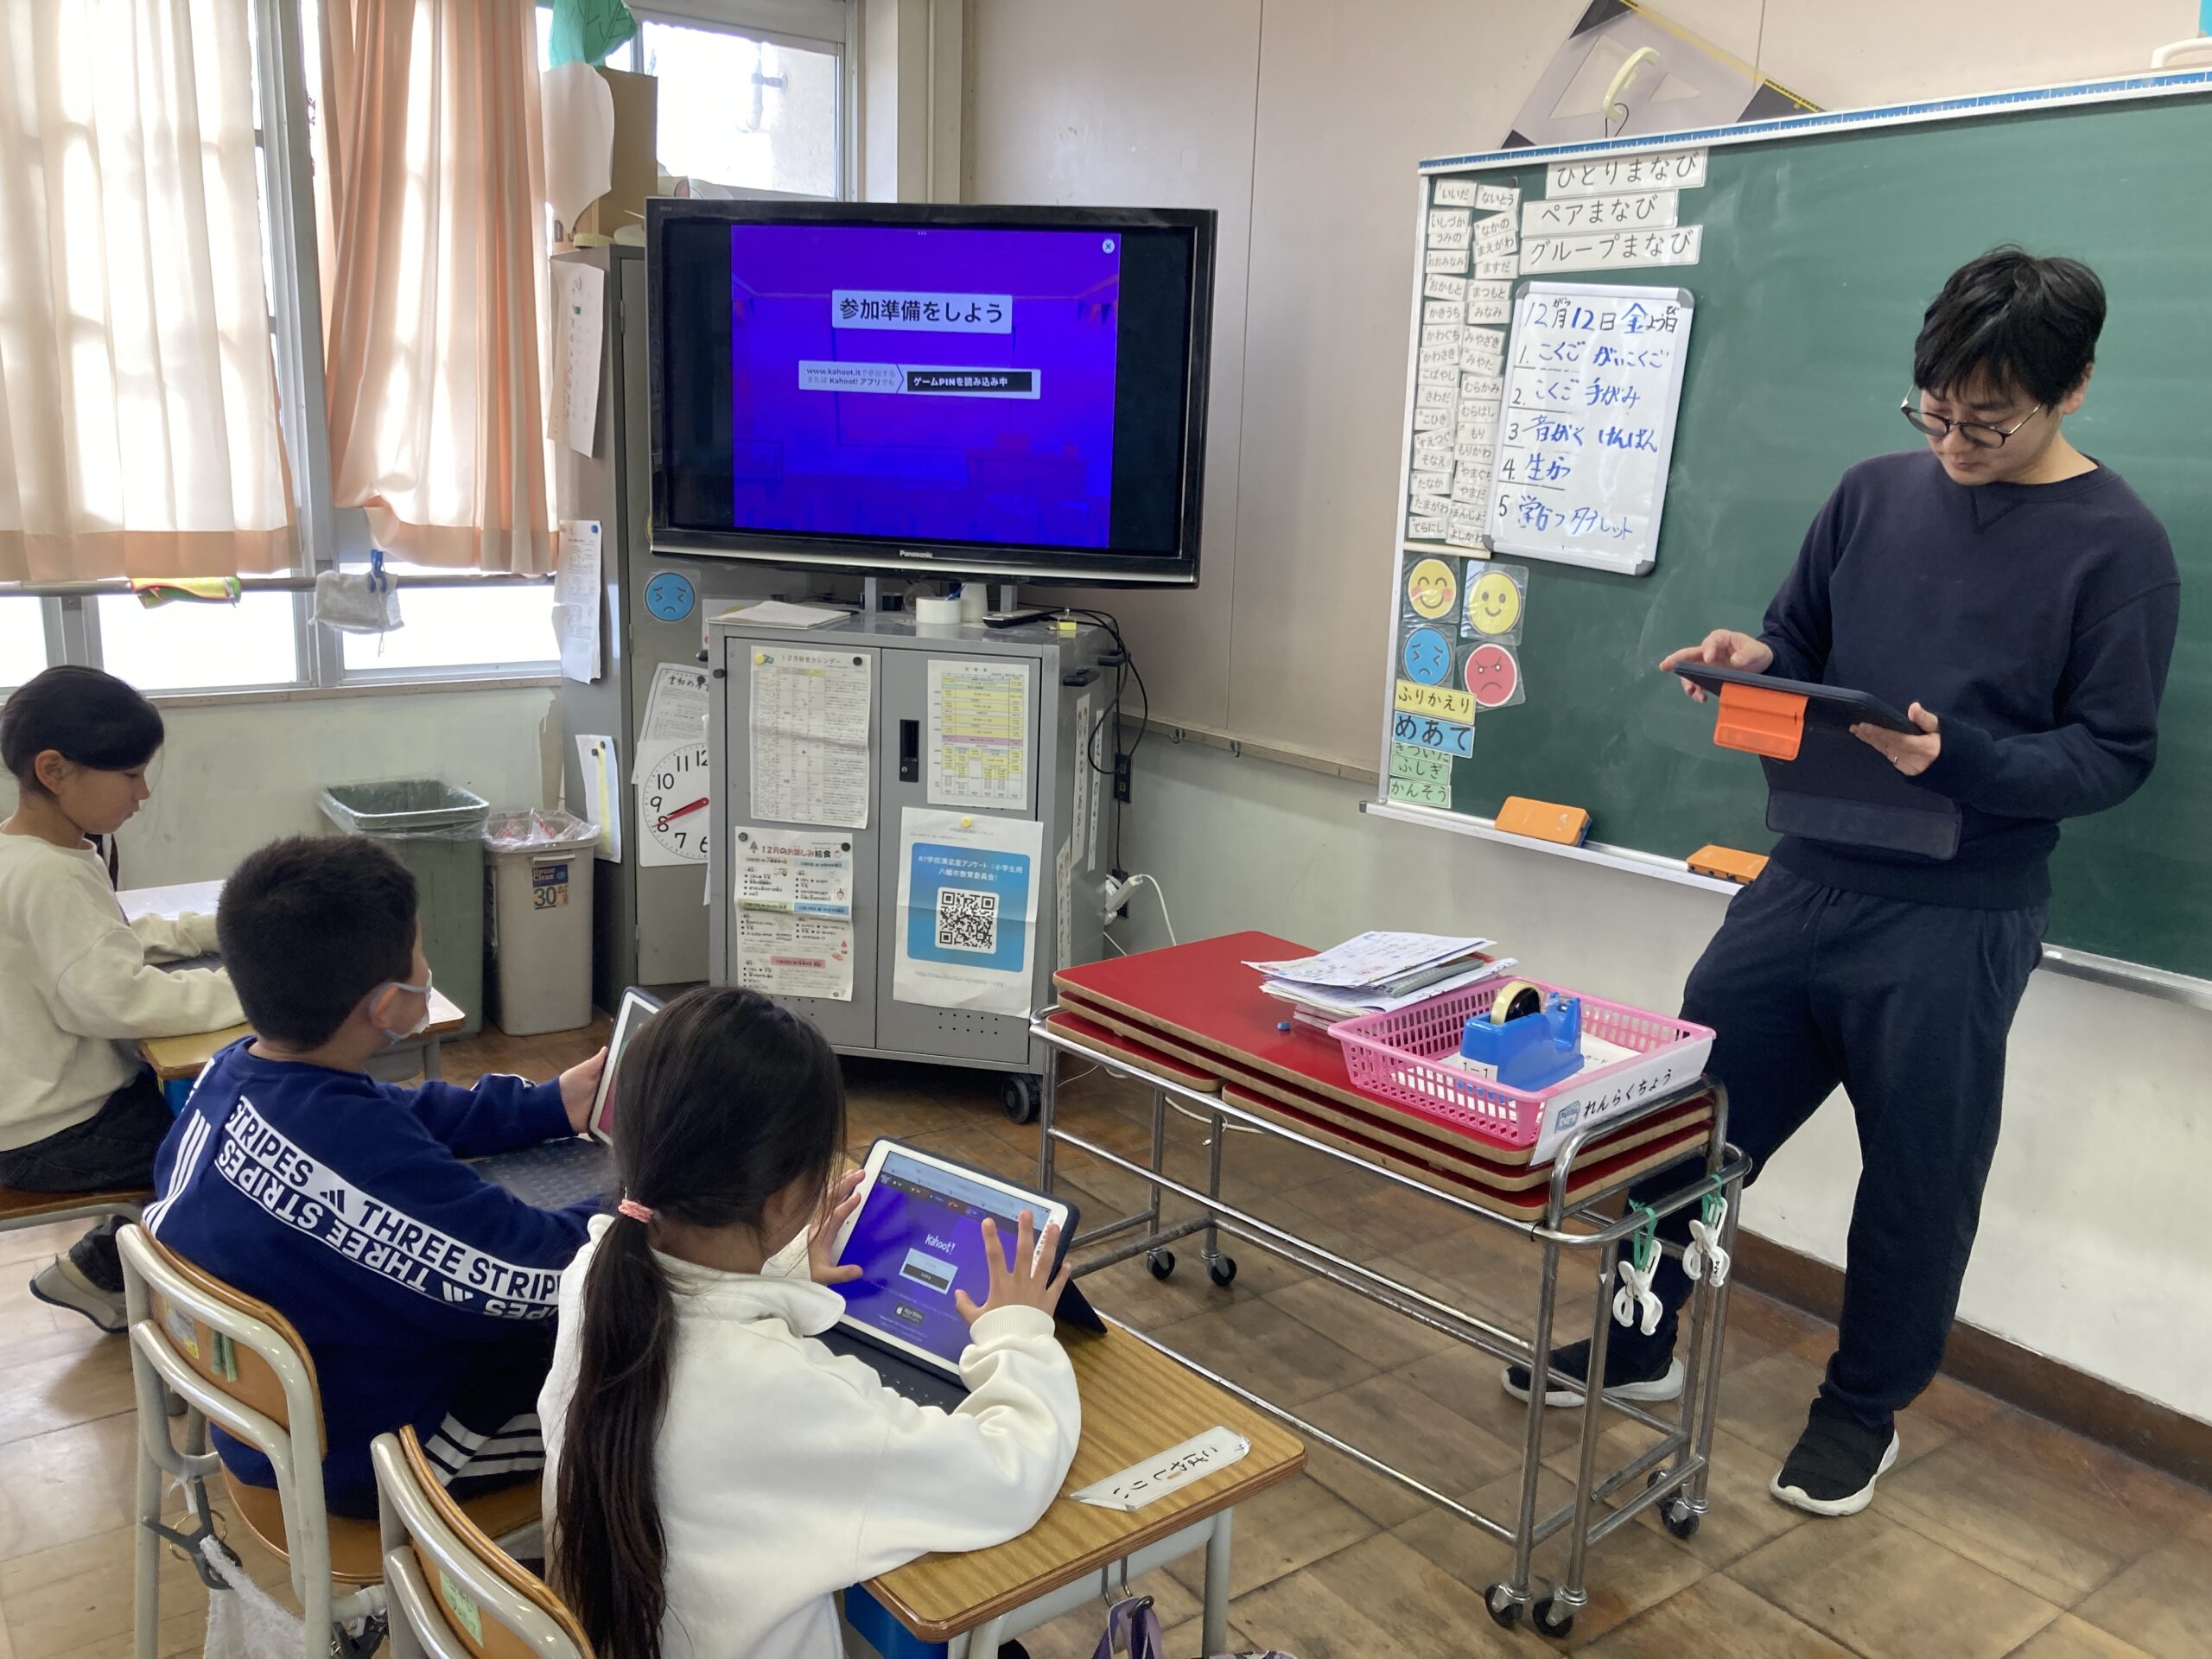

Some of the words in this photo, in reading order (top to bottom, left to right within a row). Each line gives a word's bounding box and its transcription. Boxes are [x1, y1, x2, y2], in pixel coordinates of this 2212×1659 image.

[1557, 151, 1700, 188] ひとりまなび
[1442, 188, 1470, 200] いいだ
[1481, 193, 1514, 207] ないとう
[1541, 194, 1658, 226] ペアまなび
[1431, 216, 1465, 229] いしづか
[1482, 218, 1510, 237] なかの
[1530, 229, 1695, 264] グループまなび
[1483, 261, 1510, 274] ますだ
[1429, 281, 1462, 296] おかもと
[1472, 286, 1506, 299] まつもと
[839, 296, 1003, 324] 参加準備をしよう
[1428, 307, 1460, 319] かきうち
[1474, 306, 1503, 318] みなみ
[1427, 330, 1460, 341] かわぐち
[1539, 340, 1586, 361] こくご
[912, 376, 1008, 388] ゲームPINを読み込み中
[1422, 369, 1456, 381] こばやし
[1464, 382, 1501, 394] むらかみ
[1535, 378, 1580, 401] こくご
[1585, 378, 1640, 409] 手がみ
[1471, 428, 1485, 440] もり
[1522, 414, 1585, 446] 音がく
[1418, 478, 1444, 490] たなか
[1498, 494, 1510, 517] 5
[1397, 686, 1470, 714] ふりかえり
[1395, 715, 1471, 751] めあて
[677, 755, 689, 772] 11
[1398, 758, 1443, 780] ふしぎ
[658, 772, 675, 790] 10
[1391, 780, 1446, 803] かんそう
[650, 795, 663, 813] 9
[658, 815, 669, 833] 8
[674, 832, 687, 849] 7
[534, 887, 556, 907] 30
[1582, 1069, 1672, 1119] れんらくちょう
[214, 1139, 325, 1230] STRIPES
[357, 1199, 467, 1275] THREE
[468, 1257, 560, 1301] STRIP
[924, 1233, 956, 1255] Kahoot!
[326, 1217, 431, 1294] THREE
